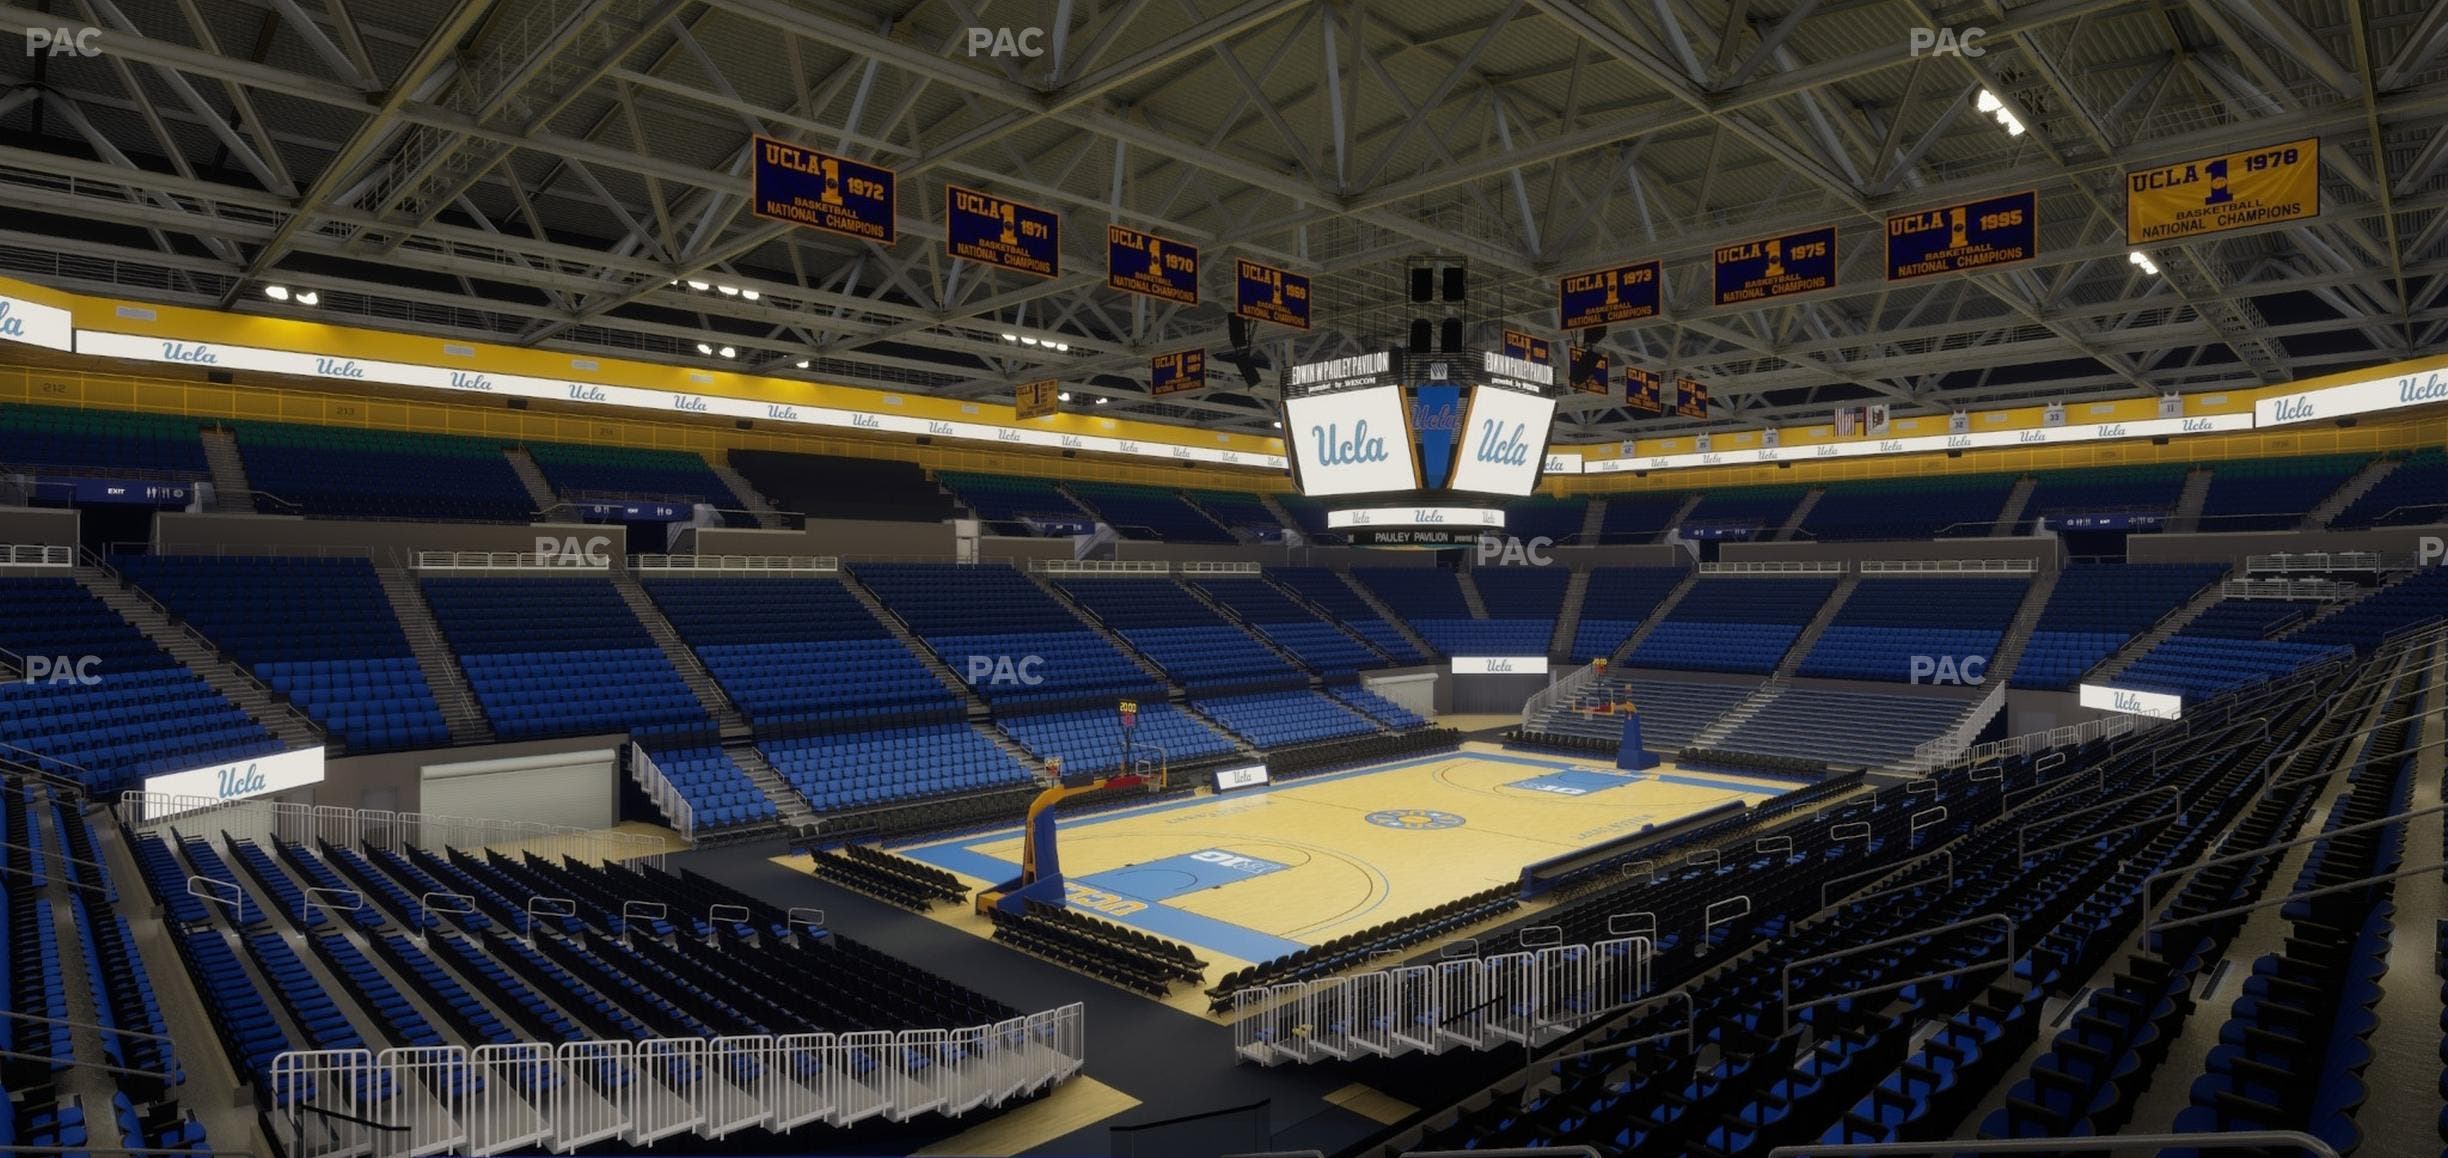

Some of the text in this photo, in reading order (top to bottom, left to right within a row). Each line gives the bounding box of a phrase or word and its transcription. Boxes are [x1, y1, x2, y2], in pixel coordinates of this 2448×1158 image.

[765, 144, 884, 206] UCLA 1 1972
[2132, 149, 2298, 205] UCLA 1 1978
[794, 197, 859, 219] BASKETBALL
[2176, 200, 2264, 220] BASKETBALL
[767, 201, 884, 237] NATIONAL CHAMPIONS
[956, 192, 1048, 246] UCLA 1 1971
[1890, 207, 2022, 248] UCLA 1 1995
[2142, 203, 2301, 238] NATIONAL CHAMPIONS
[957, 242, 1051, 273] NATIONAL CHAMPIONS
[978, 238, 1030, 257] BASKETBALL
[1111, 228, 1194, 276] UCLA 1 1970
[1925, 243, 1994, 261] BASKETBALL
[1717, 240, 1826, 278] UCLA 1 1975
[1898, 247, 2022, 278] NATIONAL CHAMPIONS
[1242, 263, 1272, 284] UCLA
[1272, 271, 1282, 304] 1
[1568, 268, 1652, 304] UCLA 1 1973
[1724, 277, 1826, 302] NATIONAL CHAMPIONS
[1744, 273, 1800, 288] BASKETBALL
[162, 342, 218, 364] Ucla
[316, 358, 364, 378] Ucla
[1352, 352, 1390, 376] PAVILION
[450, 372, 492, 390] Ucla
[2400, 373, 2448, 402] Ucla
[568, 384, 606, 402] Ucla
[673, 394, 707, 412] Ucla
[768, 404, 798, 420] Ucla
[2274, 396, 2314, 421] Ucla
[852, 413, 880, 428] Ucla
[929, 422, 953, 435] Ucla
[2098, 424, 2126, 438] Ucla
[2182, 418, 2214, 432] Ucla
[998, 428, 1020, 442] Ucla
[1062, 435, 1082, 447] Ucla
[1312, 419, 1389, 467] Ucla
[1476, 418, 1530, 466] Ucla
[1948, 436, 1971, 447] Ucla
[2020, 430, 2046, 442] Ucla
[1414, 510, 1444, 523] Ucla
[1375, 532, 1410, 543] PAULEY
[1414, 531, 1448, 542] PAVILION
[1486, 658, 1512, 672] Ucla
[2114, 691, 2142, 712] Ucla
[218, 763, 266, 798] Ucla
[1234, 770, 1252, 784] Ucla
